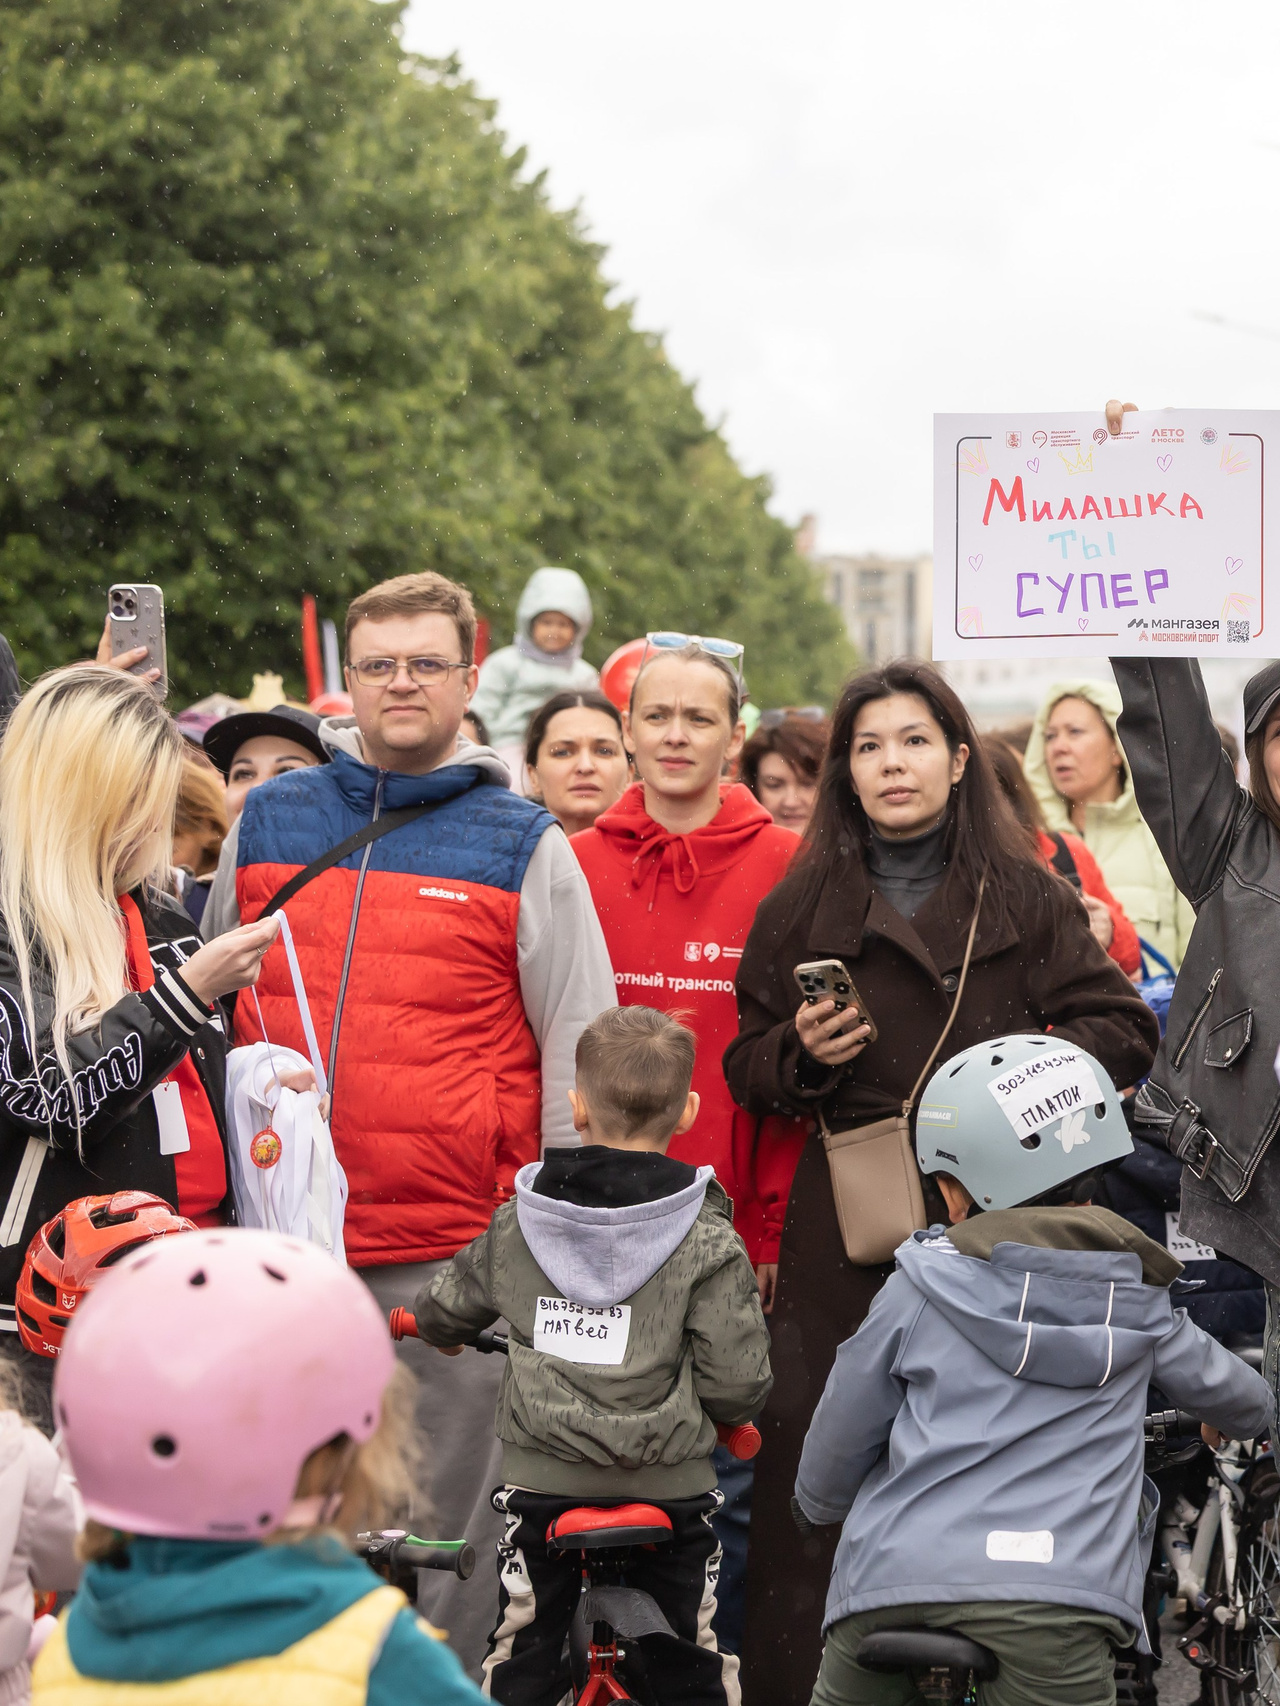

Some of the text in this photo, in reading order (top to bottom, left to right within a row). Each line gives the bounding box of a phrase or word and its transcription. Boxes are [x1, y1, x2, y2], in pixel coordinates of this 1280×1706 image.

[1152, 428, 1185, 437] ЛЕТО
[1017, 568, 1170, 618] СУПЕР
[1152, 631, 1220, 643] МОСКОВСКИЙ СПОРТ
[418, 886, 456, 900] adidas
[667, 976, 737, 996] транспо
[1020, 1085, 1082, 1128] ПЛАТОН
